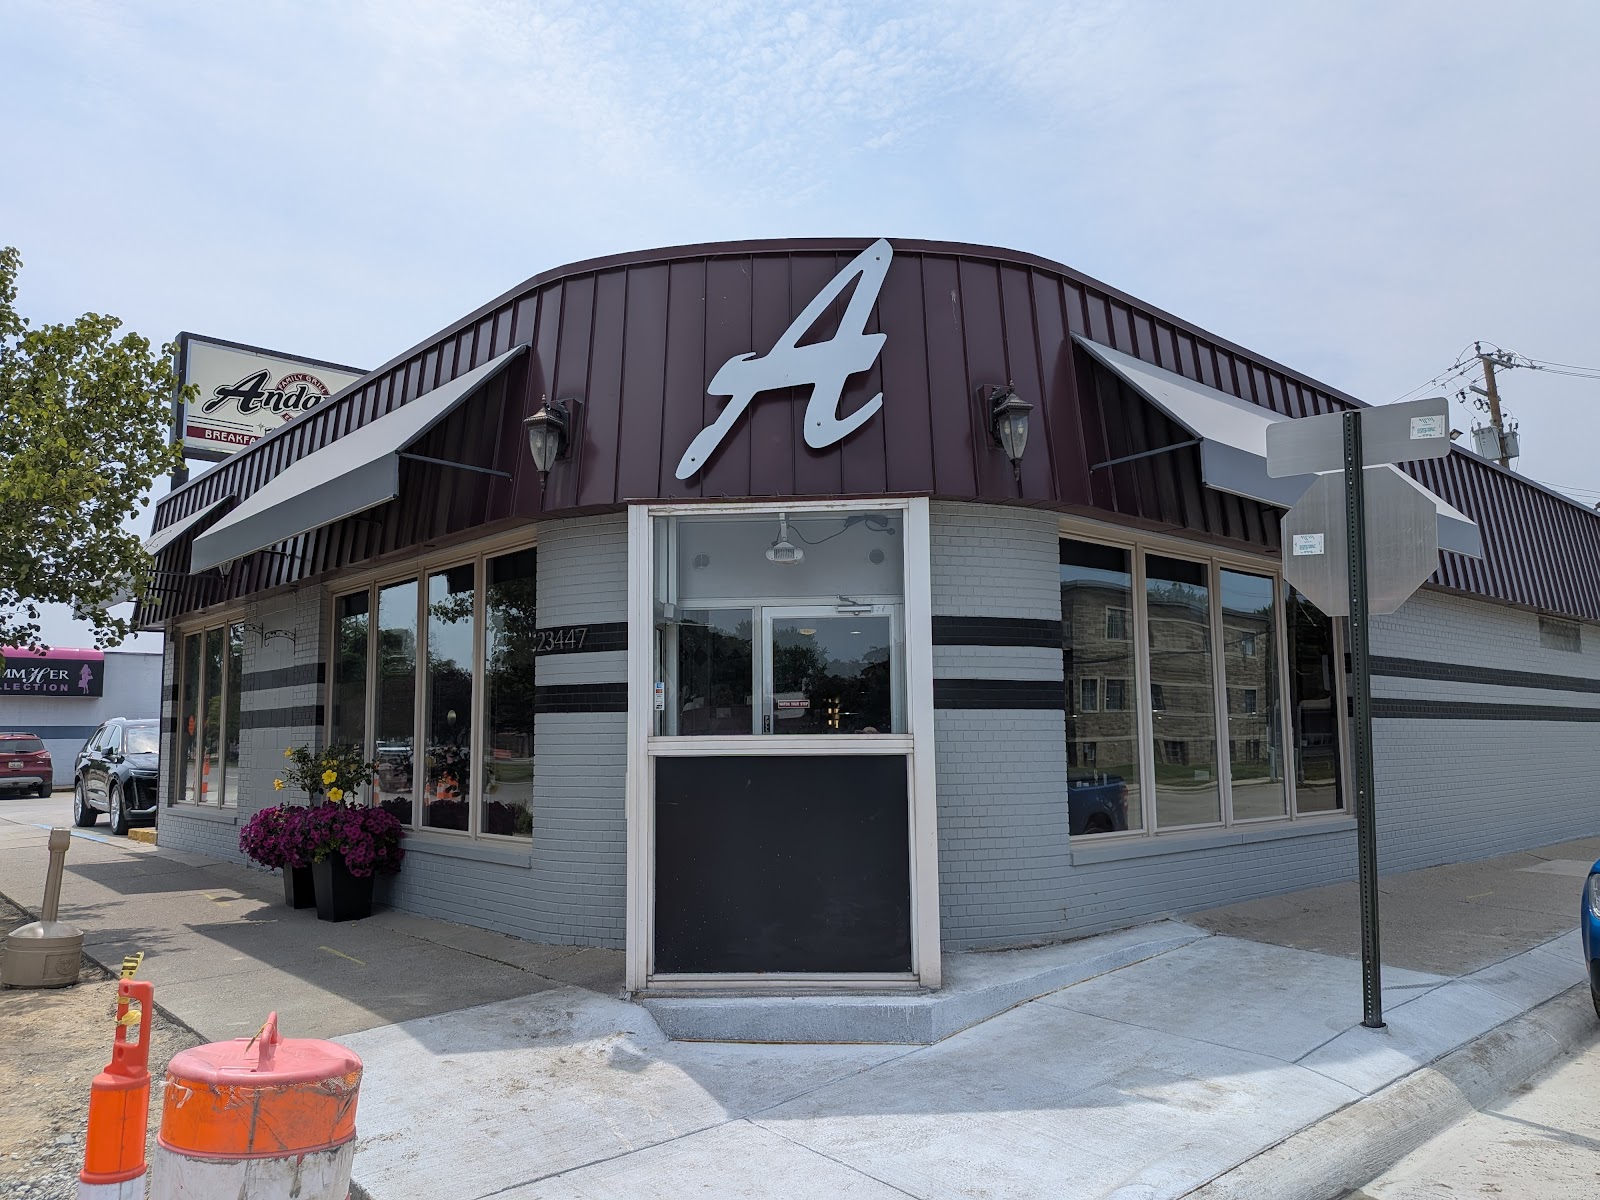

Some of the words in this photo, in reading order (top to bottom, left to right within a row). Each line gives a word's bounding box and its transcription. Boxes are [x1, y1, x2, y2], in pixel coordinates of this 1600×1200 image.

[675, 238, 893, 480] A
[202, 368, 333, 414] Anda
[279, 374, 303, 390] FAMILY
[305, 376, 326, 393] GRILL
[205, 429, 261, 445] BREAKFA
[537, 628, 588, 651] 23447
[0, 682, 69, 691] LECTION
